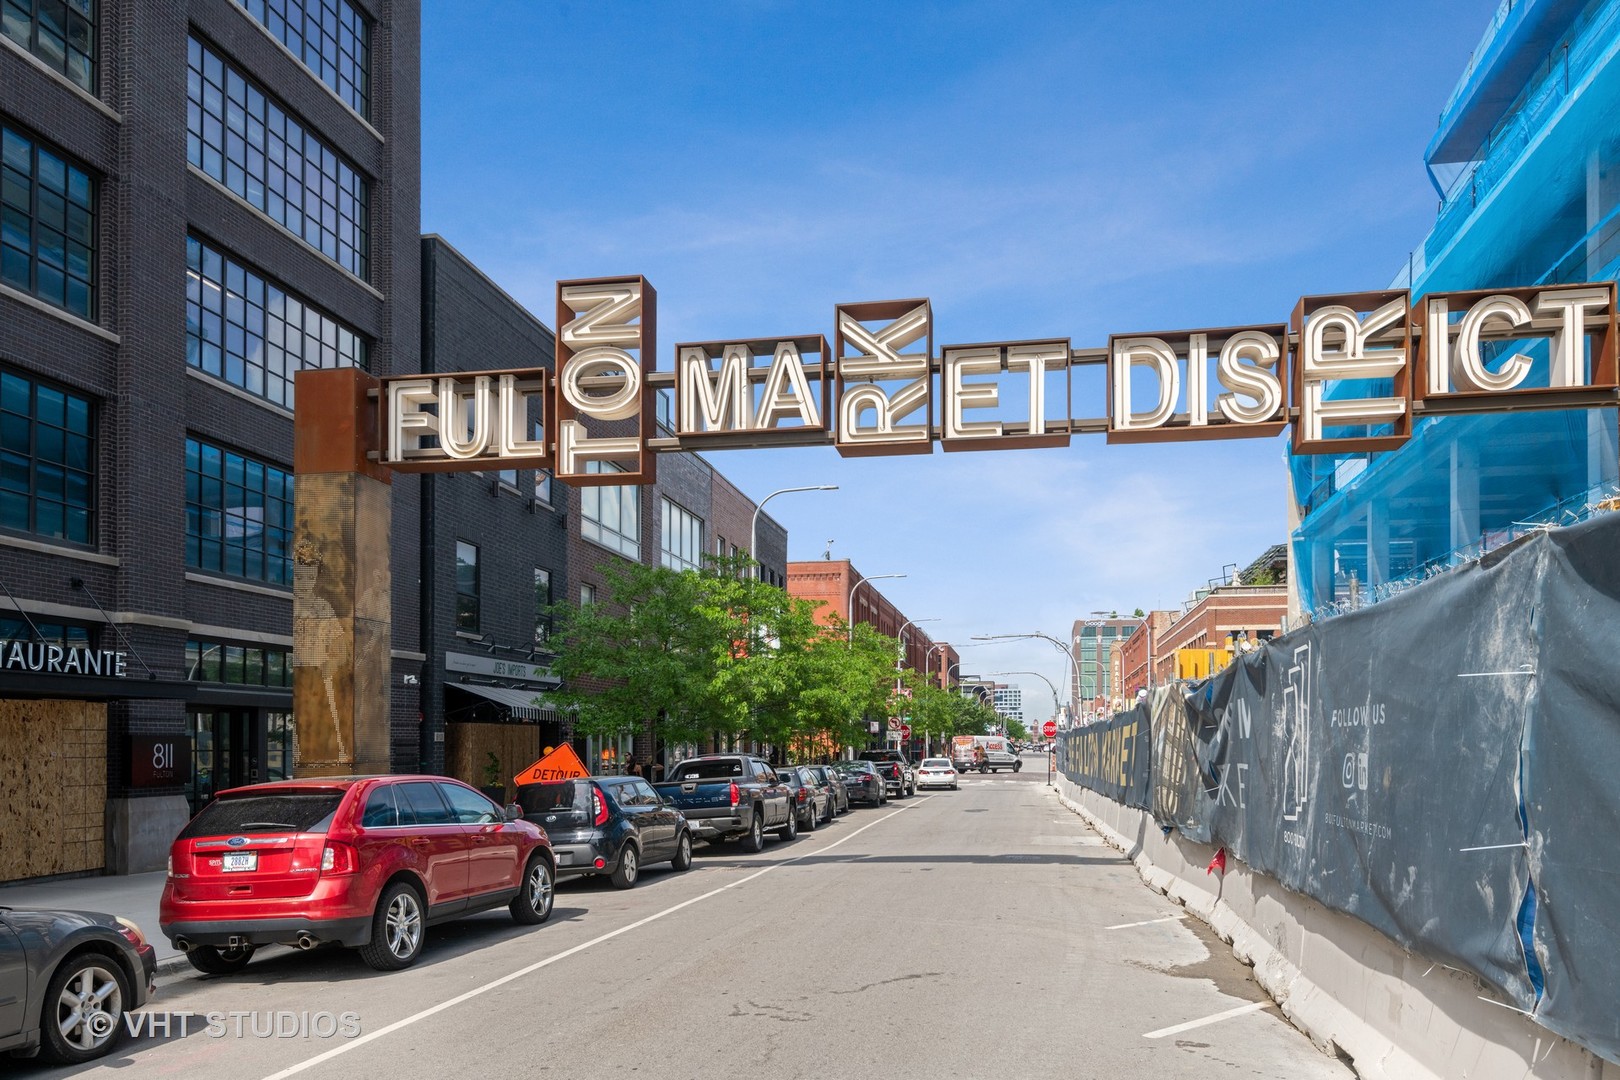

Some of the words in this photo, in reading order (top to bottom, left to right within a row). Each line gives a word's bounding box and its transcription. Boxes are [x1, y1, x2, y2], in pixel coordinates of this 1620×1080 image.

[1330, 705, 1370, 728] FOLLOW
[1372, 703, 1386, 724] US
[1043, 725, 1056, 733] STOP
[152, 743, 174, 769] 811
[532, 768, 581, 781] DETOUR
